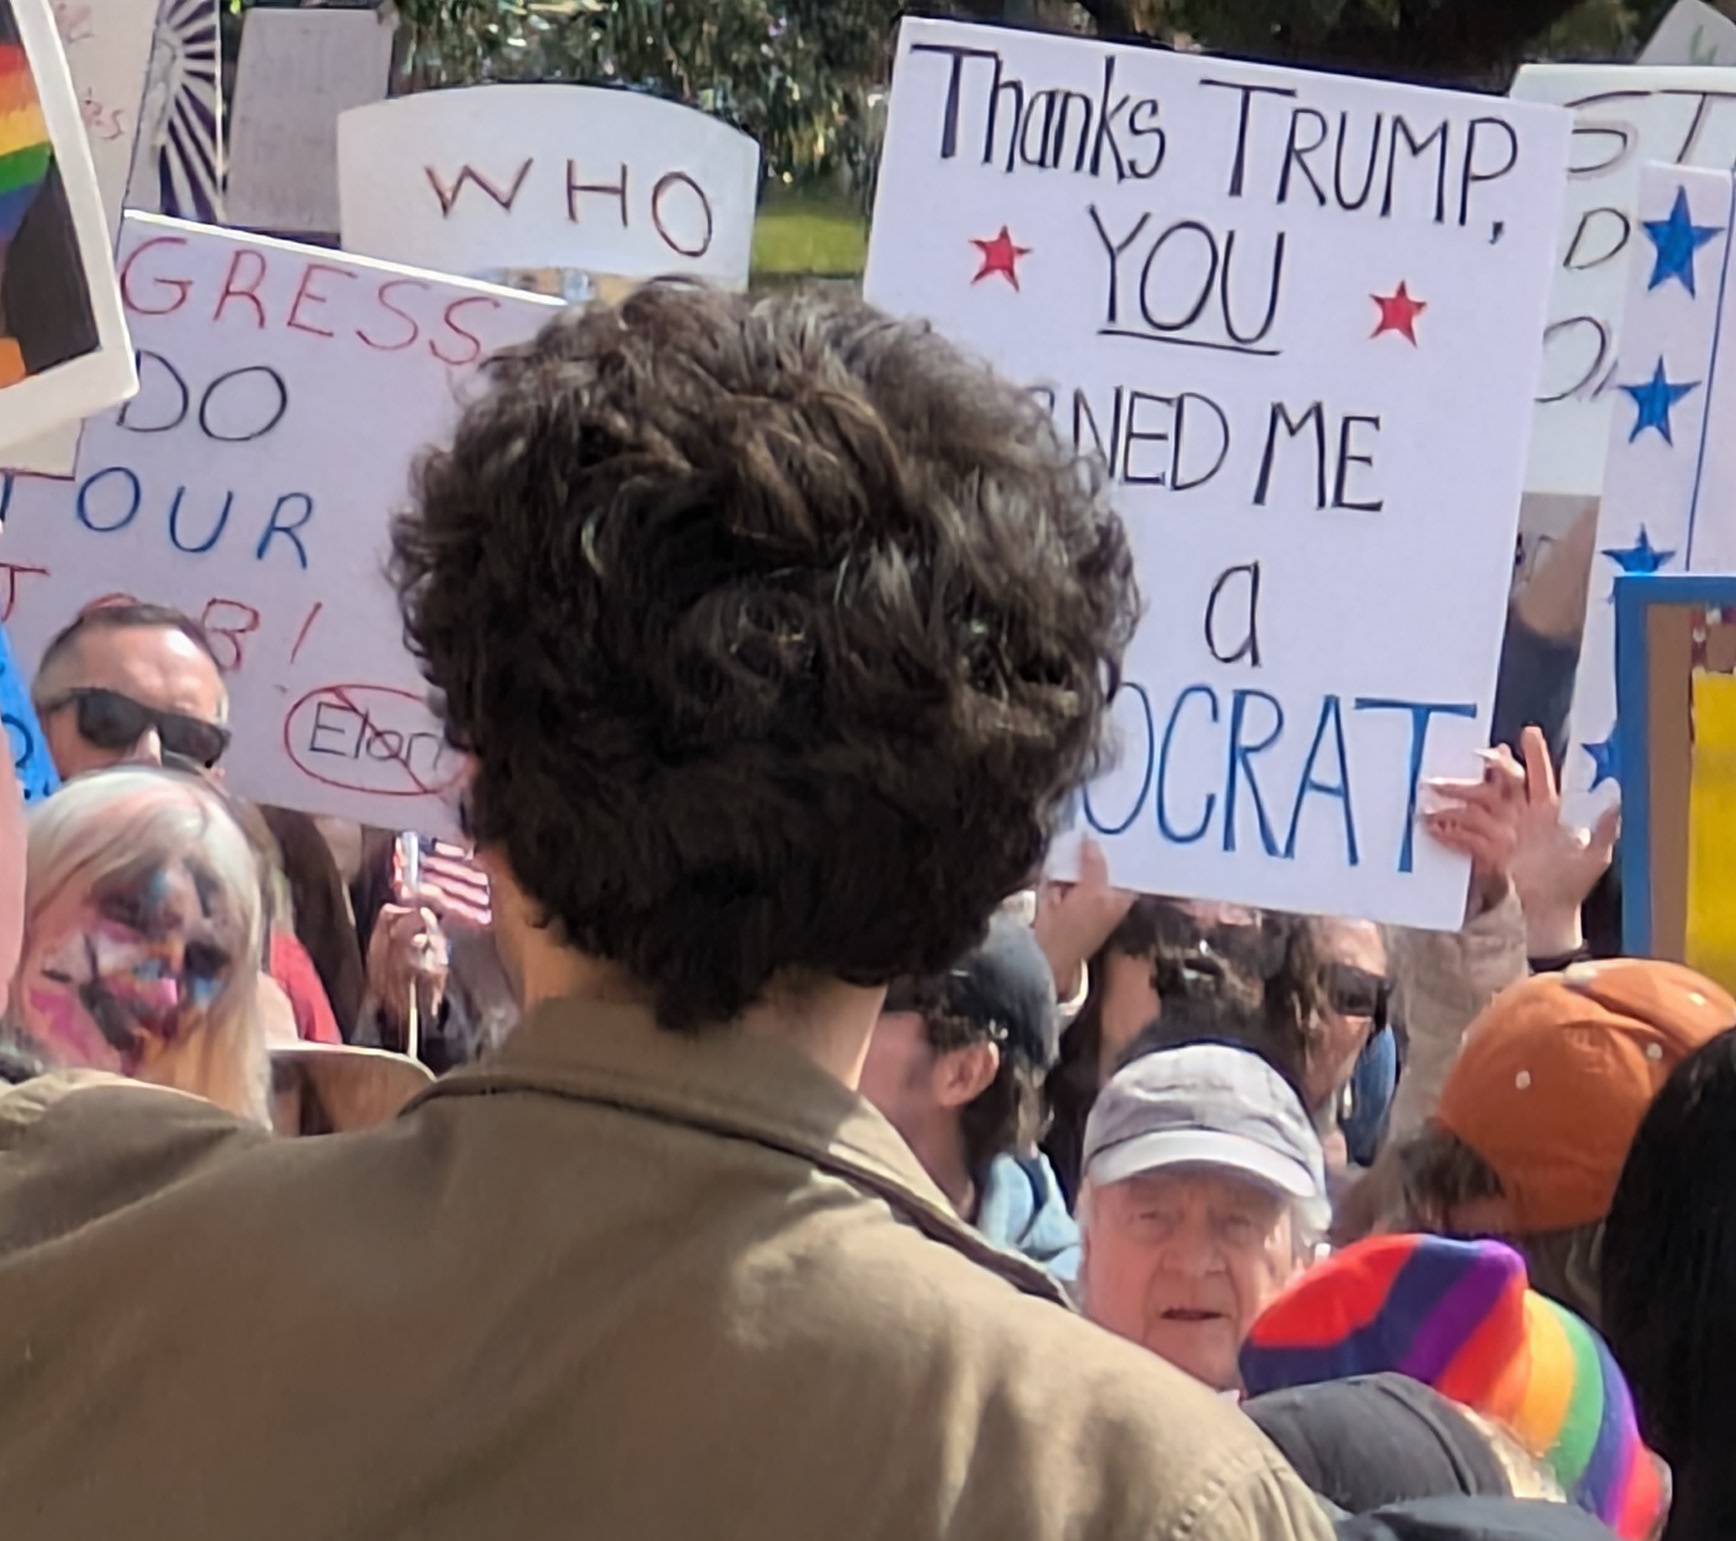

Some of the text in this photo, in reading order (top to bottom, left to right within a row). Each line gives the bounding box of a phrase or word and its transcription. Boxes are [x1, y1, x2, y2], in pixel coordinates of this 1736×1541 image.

[910, 43, 1519, 244] Thanks TRUMP,
[424, 156, 713, 258] WHO
[120, 235, 502, 366] GRESS
[1088, 203, 1286, 346] YOU
[116, 349, 288, 442] DO
[1252, 398, 1384, 512] ME
[1204, 560, 1262, 668] a
